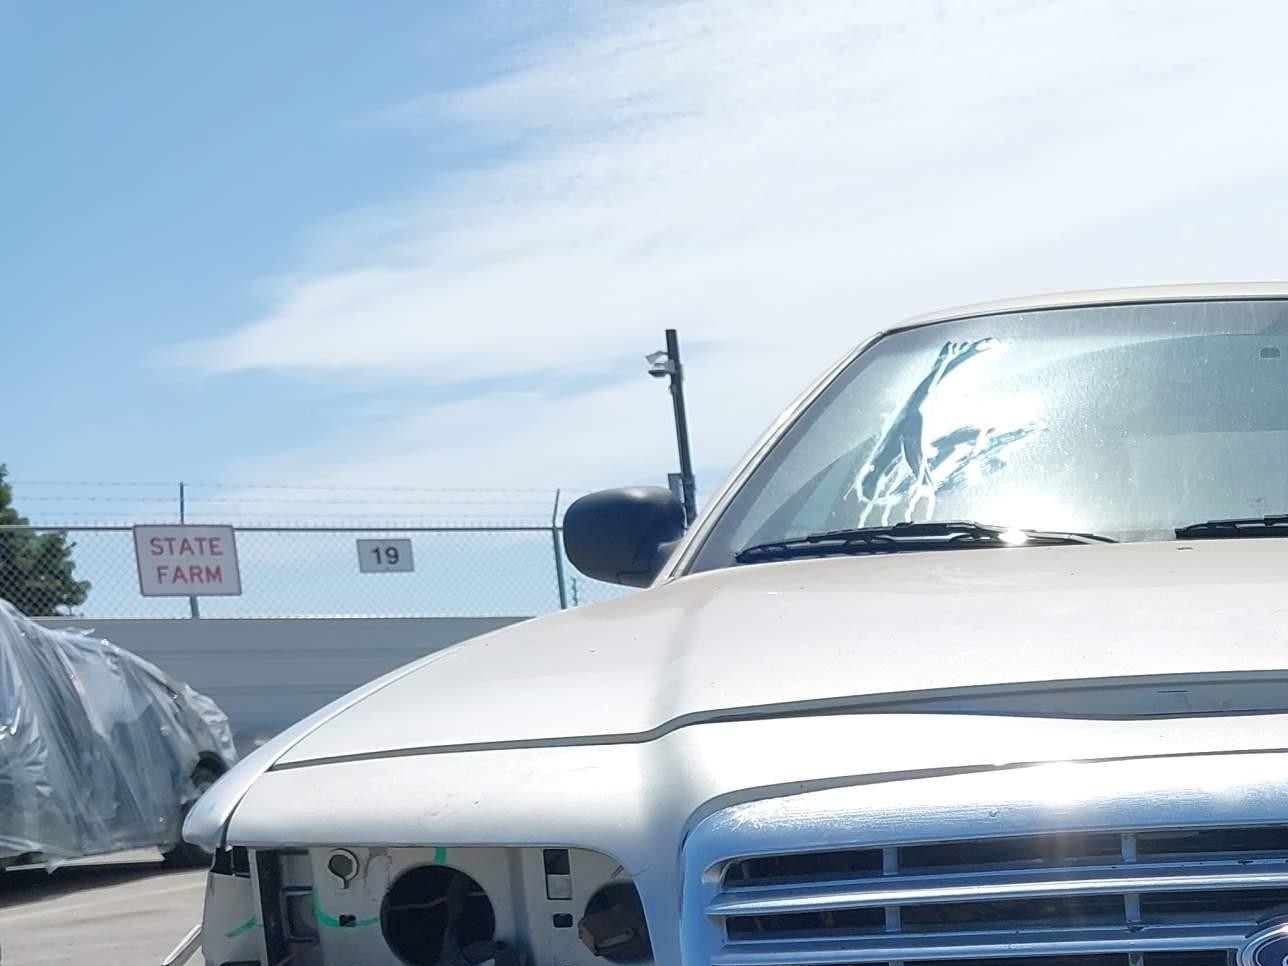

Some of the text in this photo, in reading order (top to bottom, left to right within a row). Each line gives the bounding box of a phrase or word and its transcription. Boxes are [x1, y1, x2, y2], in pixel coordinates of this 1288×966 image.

[150, 537, 223, 556] STATE
[371, 546, 399, 565] 19
[157, 565, 223, 584] FARM
